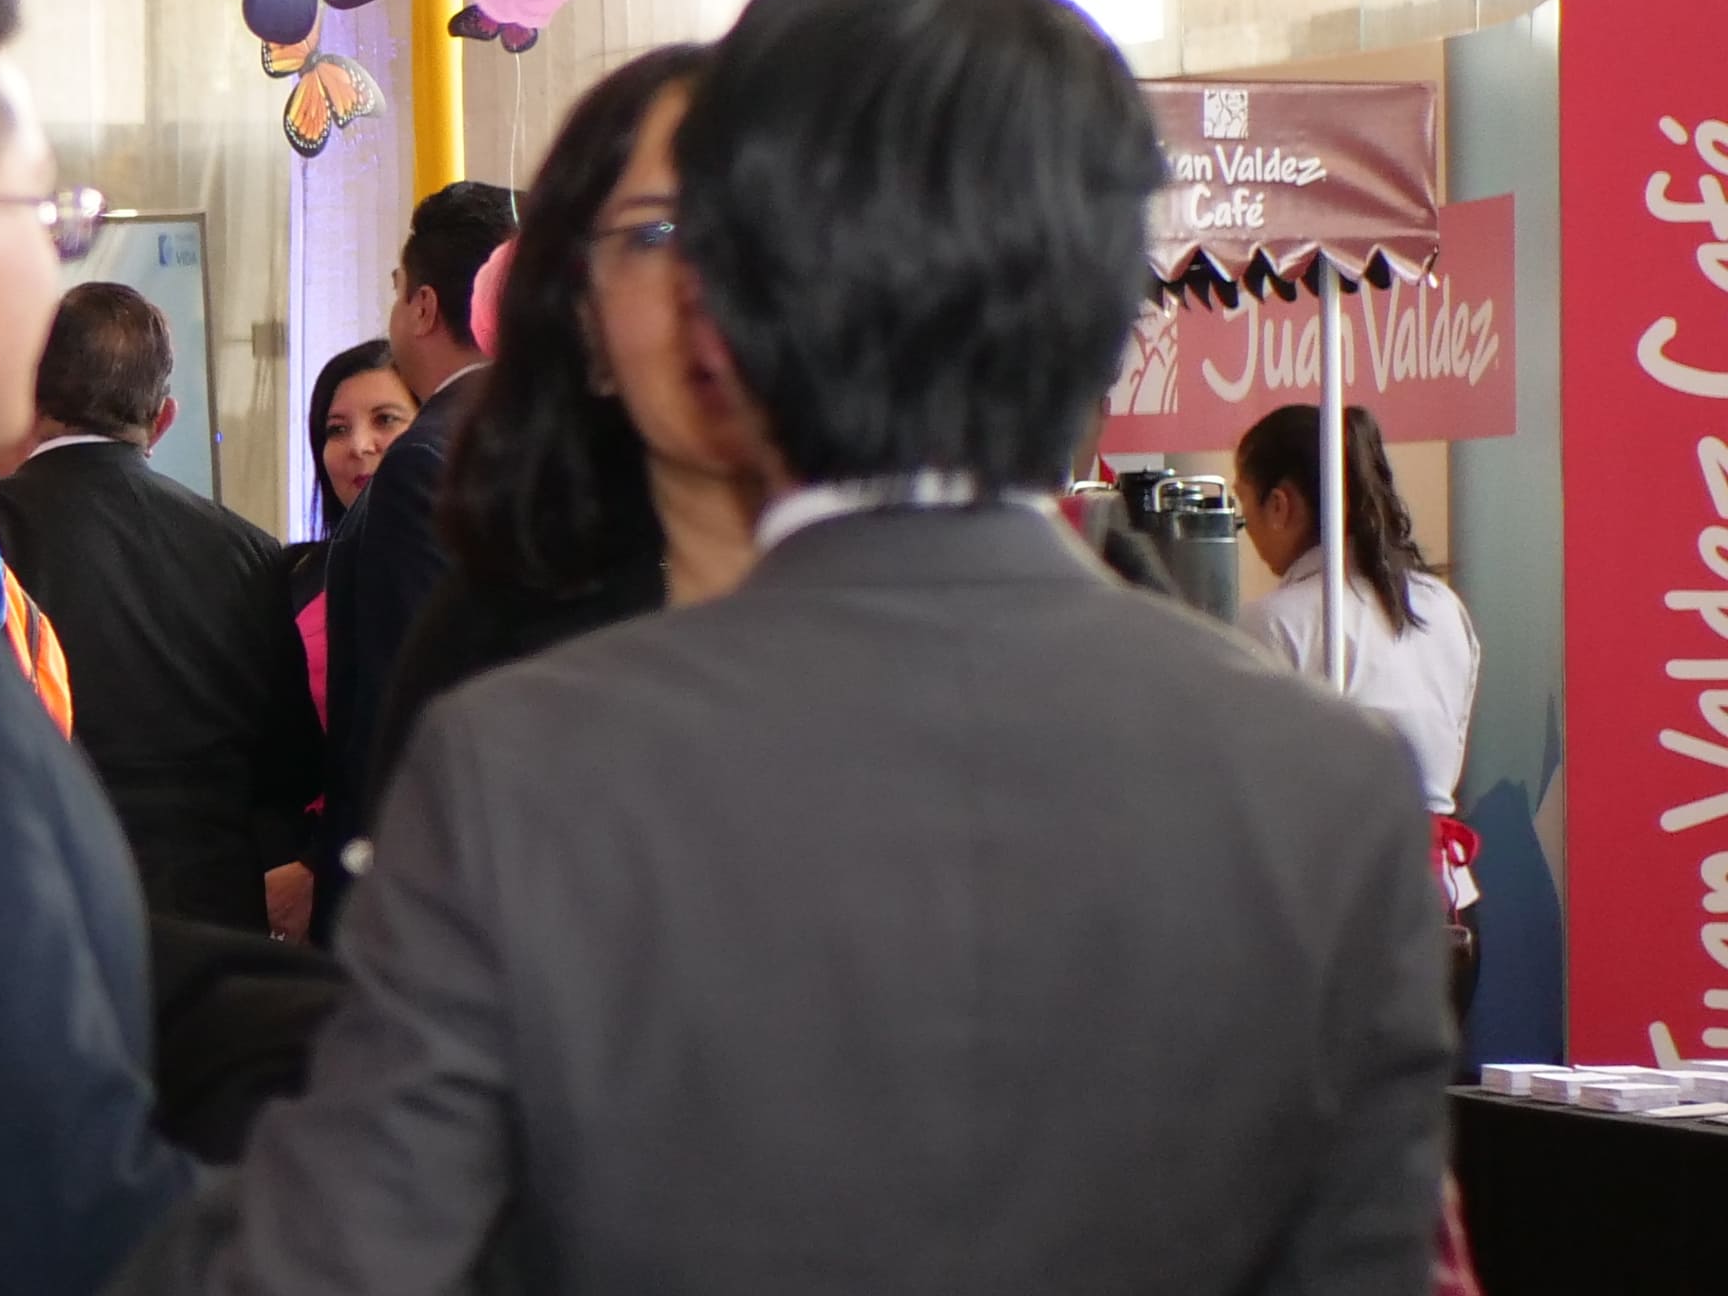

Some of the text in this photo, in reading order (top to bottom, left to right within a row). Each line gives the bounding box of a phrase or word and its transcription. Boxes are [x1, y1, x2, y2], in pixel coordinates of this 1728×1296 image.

[1215, 144, 1327, 186] Valdez
[1190, 184, 1264, 229] Café
[1361, 274, 1499, 393] Valdez
